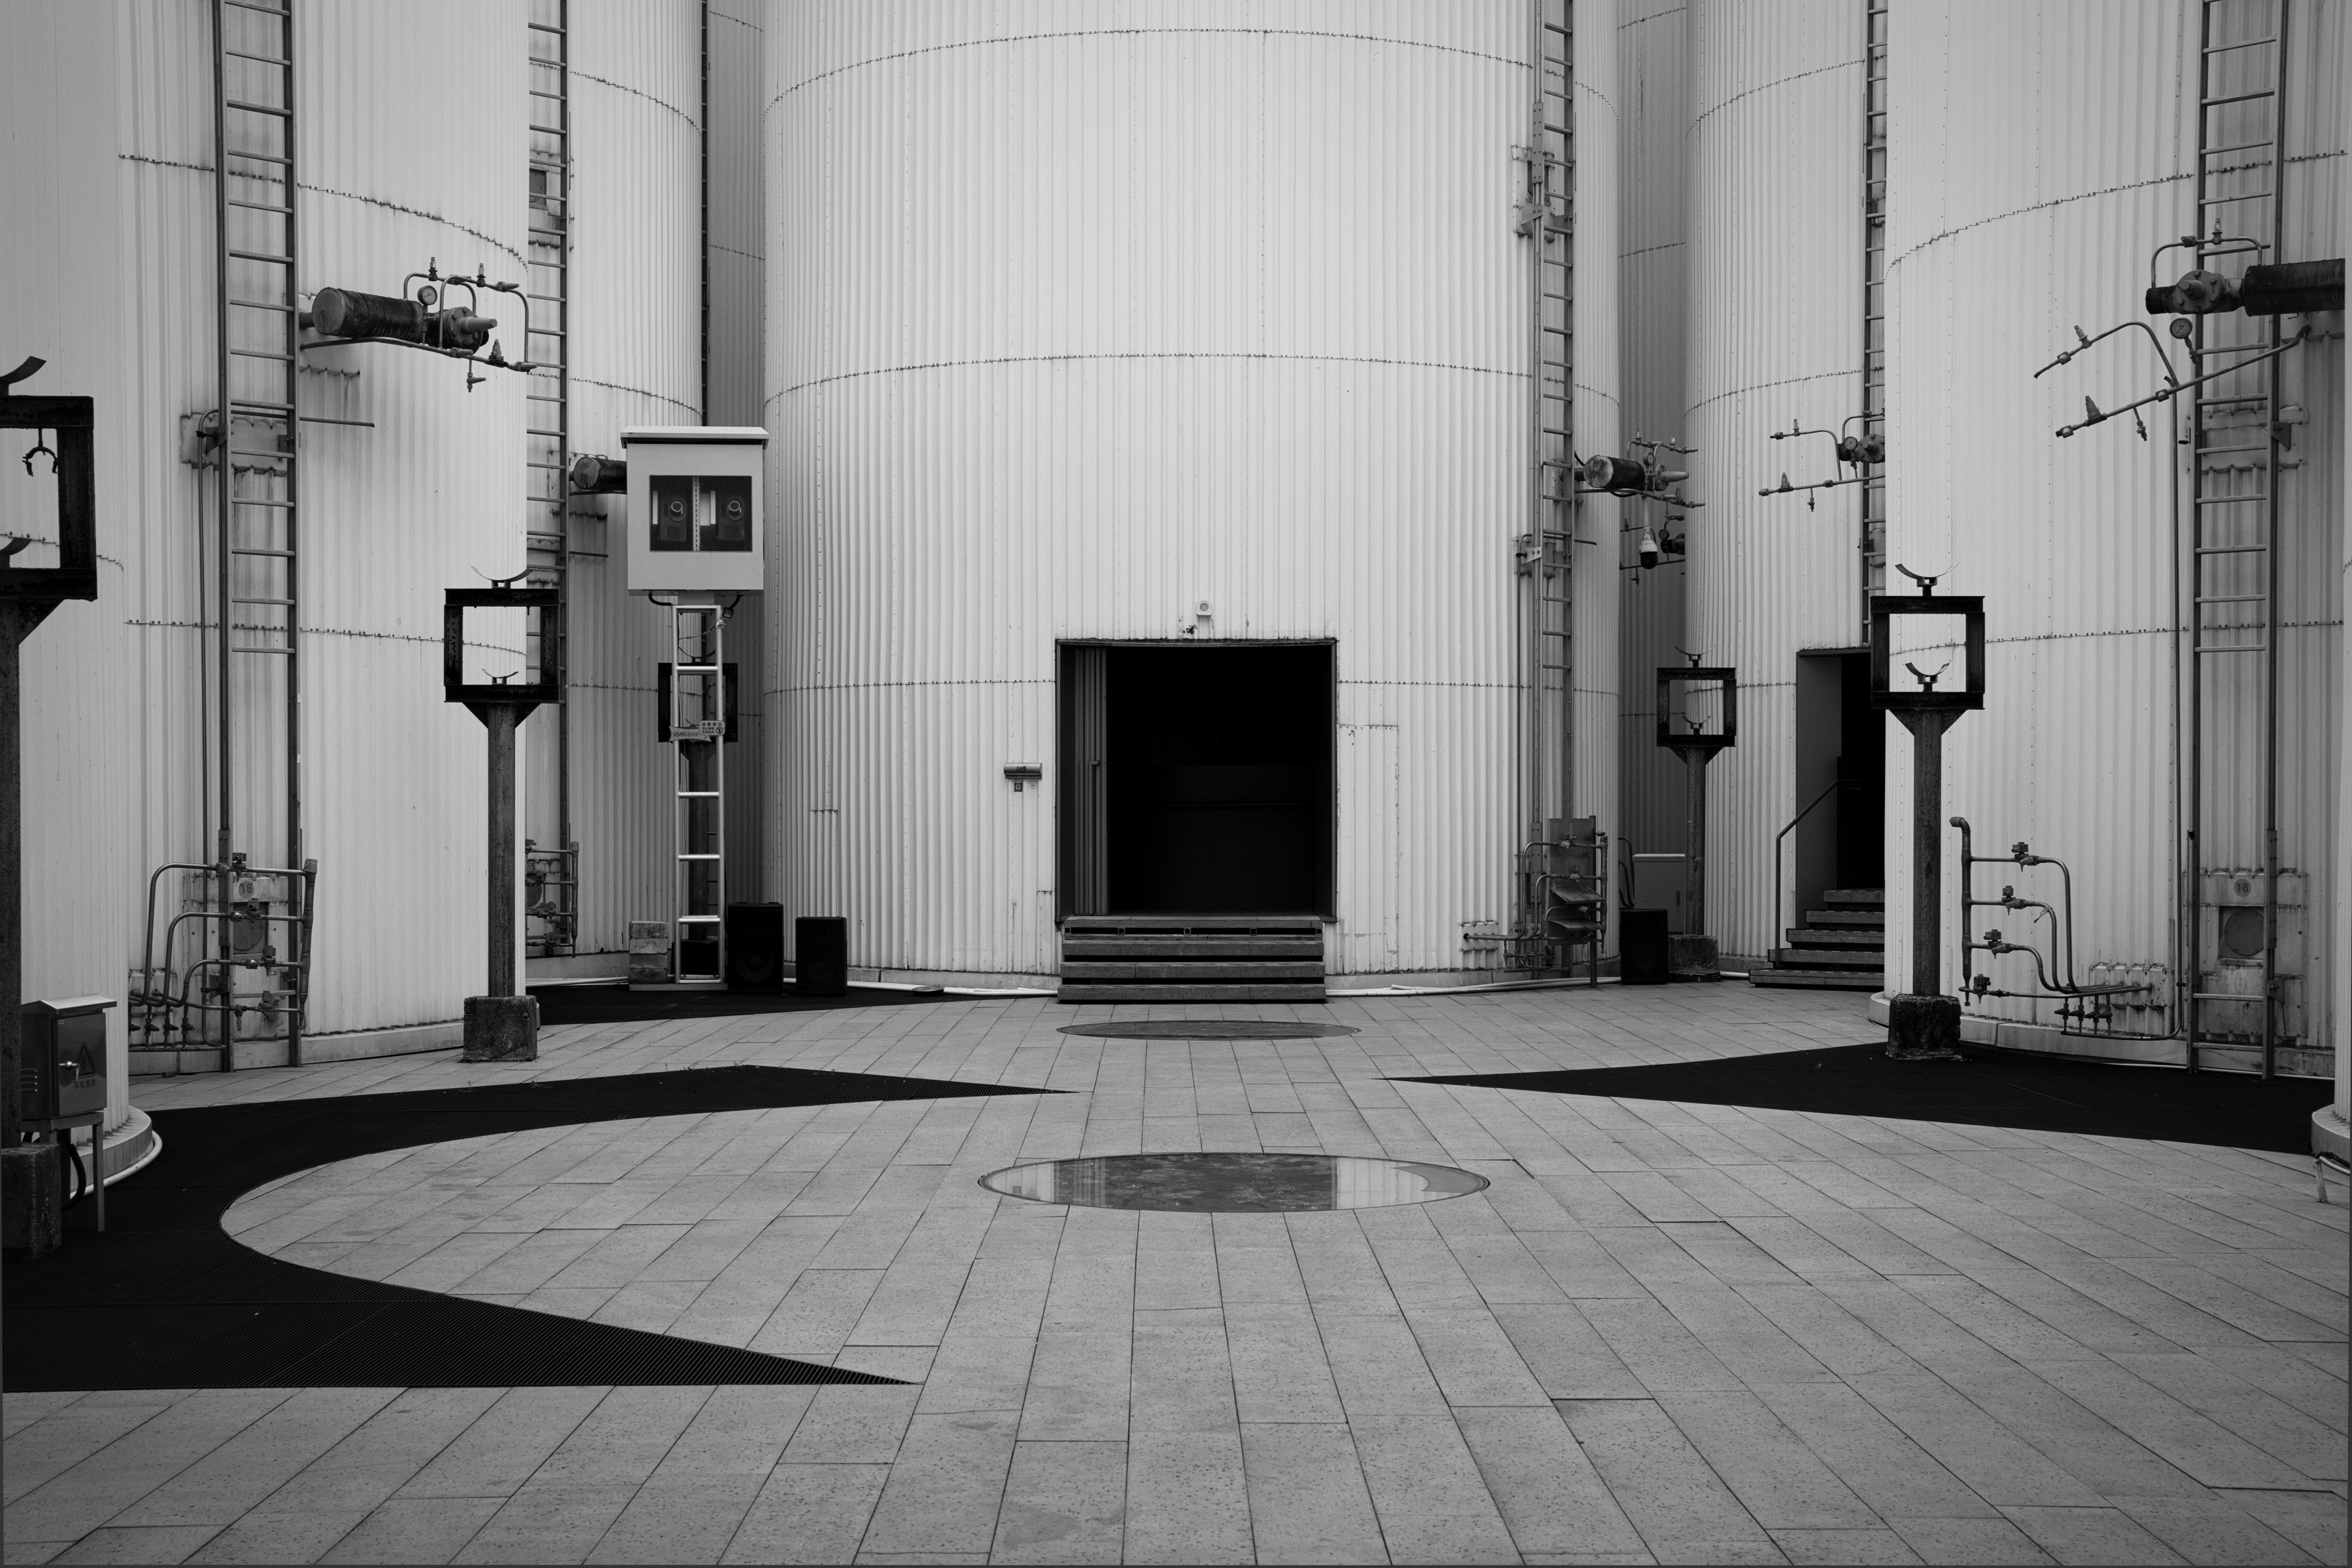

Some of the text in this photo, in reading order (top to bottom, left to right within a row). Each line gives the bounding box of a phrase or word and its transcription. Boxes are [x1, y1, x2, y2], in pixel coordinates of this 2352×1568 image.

[242, 884, 252, 893] 18
[2237, 883, 2248, 892] 16
[74, 1078, 96, 1090] 有电危险
